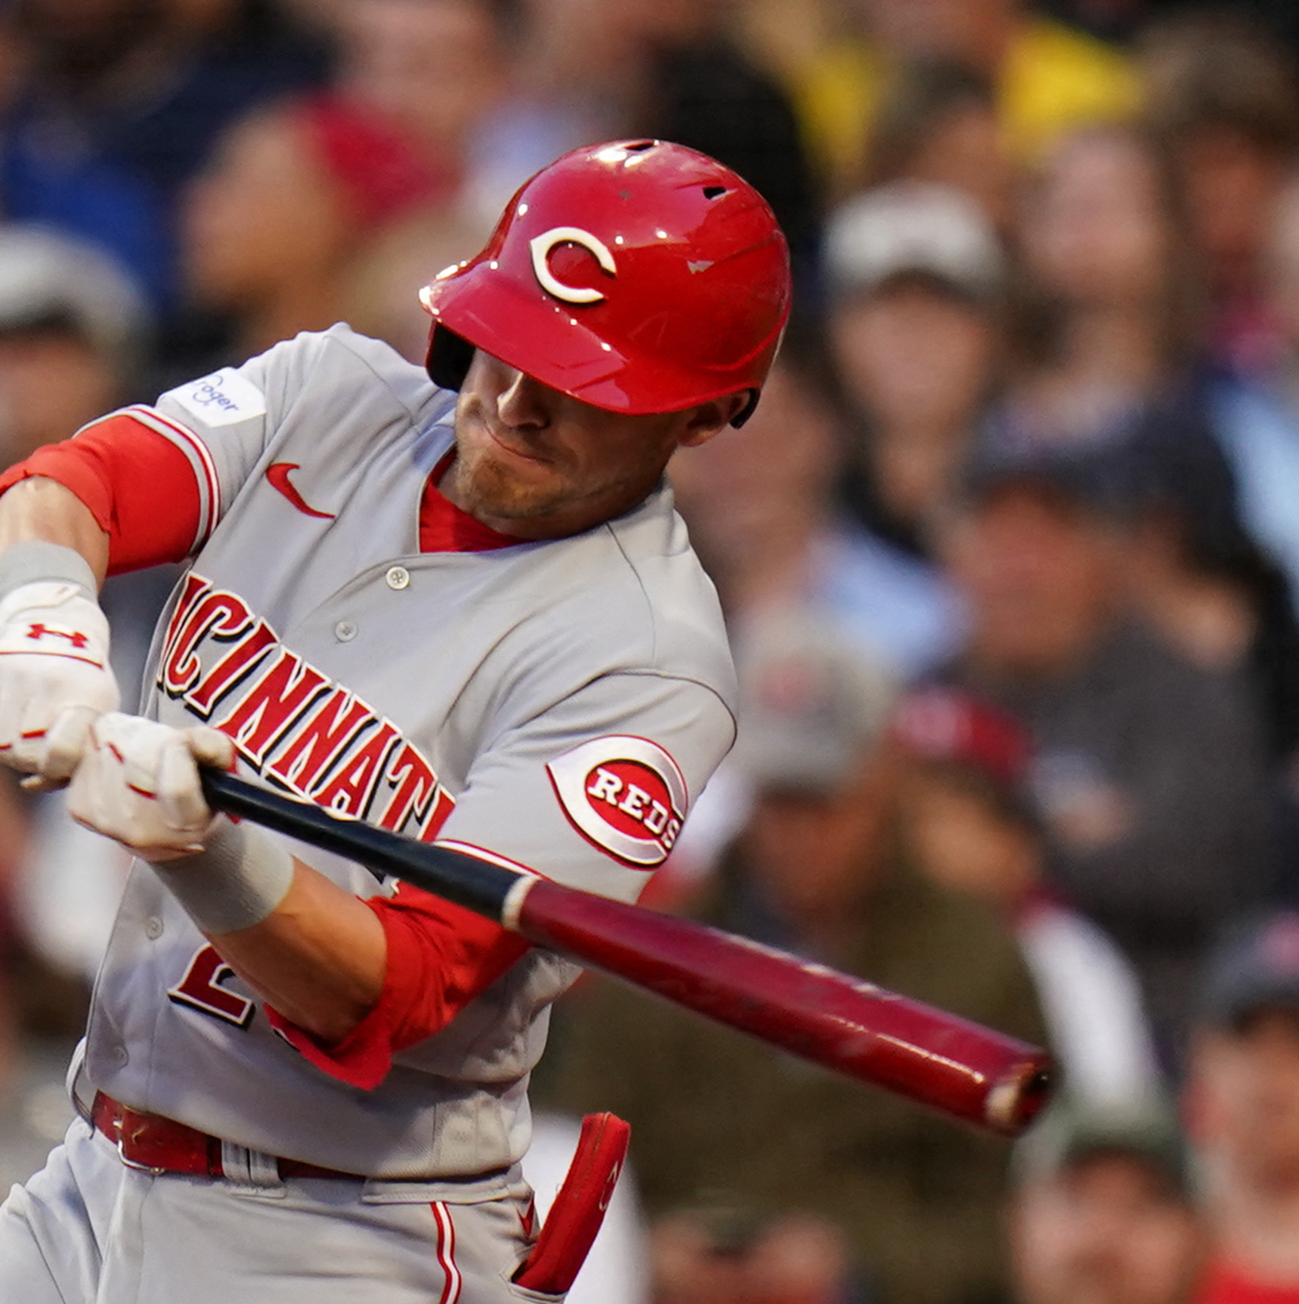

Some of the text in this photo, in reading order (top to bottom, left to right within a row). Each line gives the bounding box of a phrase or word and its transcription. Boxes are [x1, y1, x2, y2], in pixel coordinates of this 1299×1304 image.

[530, 226, 617, 304] C
[192, 374, 240, 411] roger
[586, 766, 681, 850] REDS
